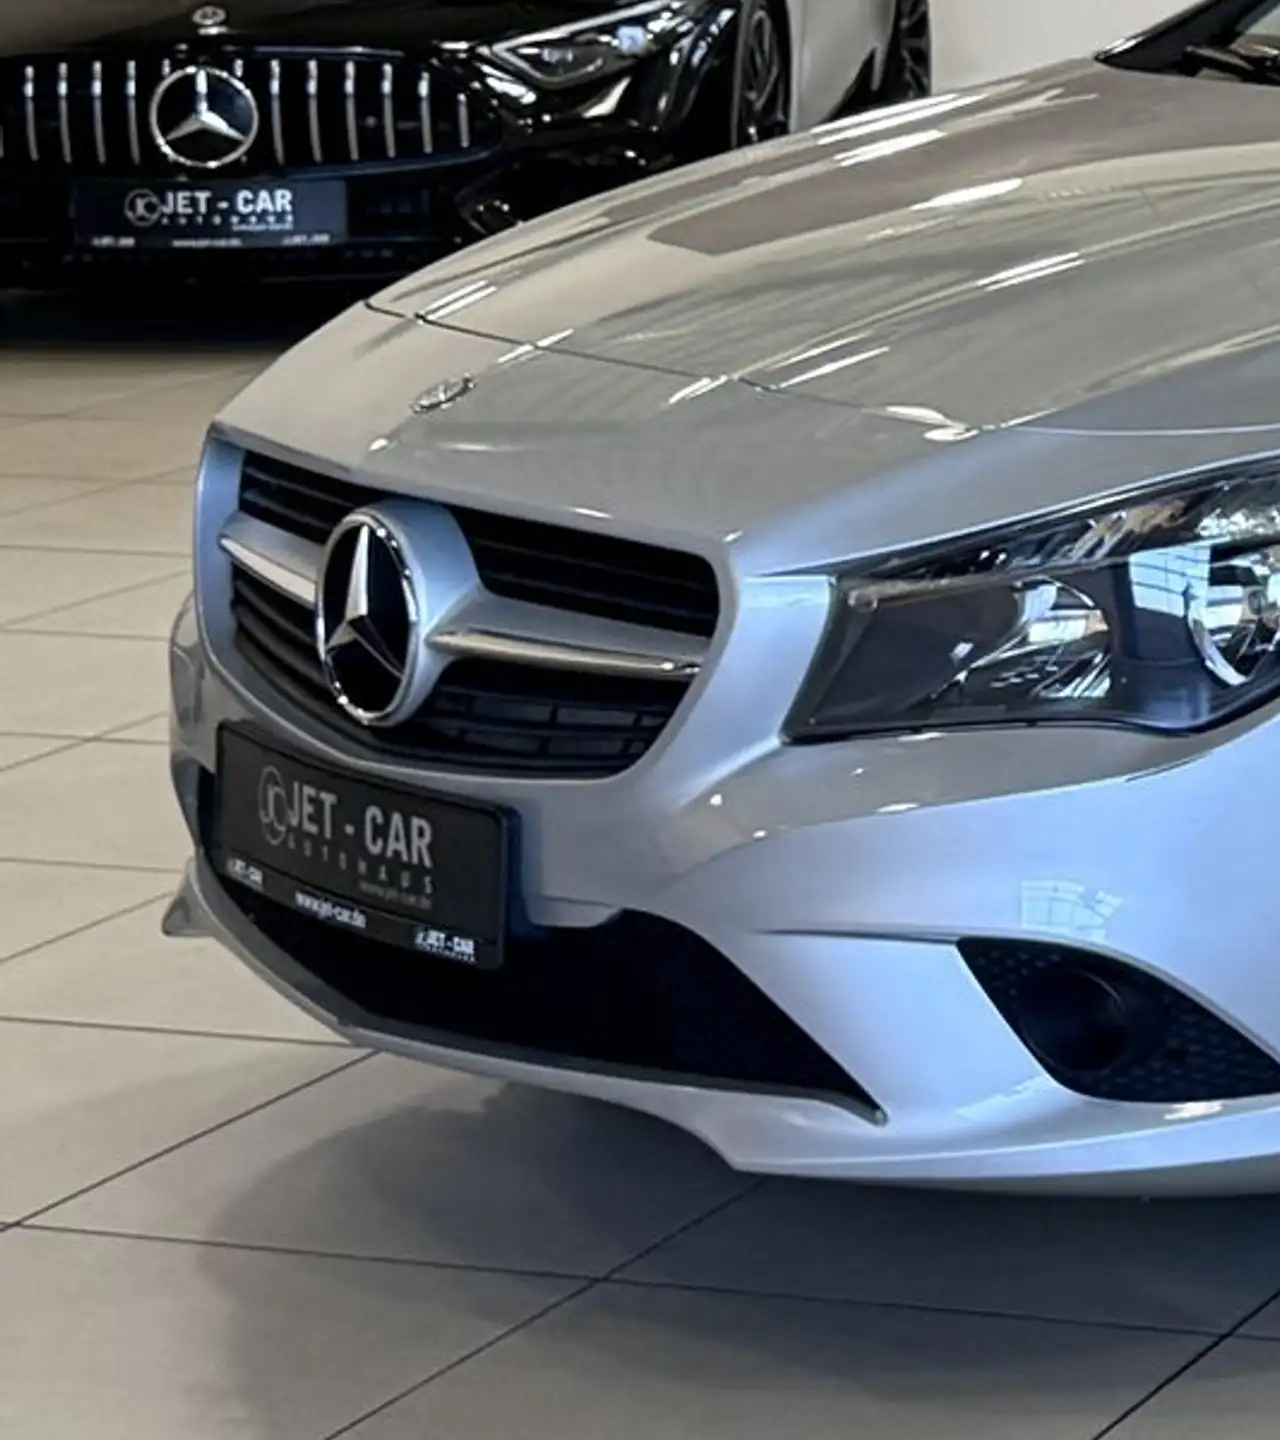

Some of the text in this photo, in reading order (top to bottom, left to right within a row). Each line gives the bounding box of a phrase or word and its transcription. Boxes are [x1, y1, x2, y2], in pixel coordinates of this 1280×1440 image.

[161, 190, 212, 215] JET
[235, 188, 294, 214] CAR
[287, 780, 338, 840] JET
[364, 804, 433, 869] CAR
